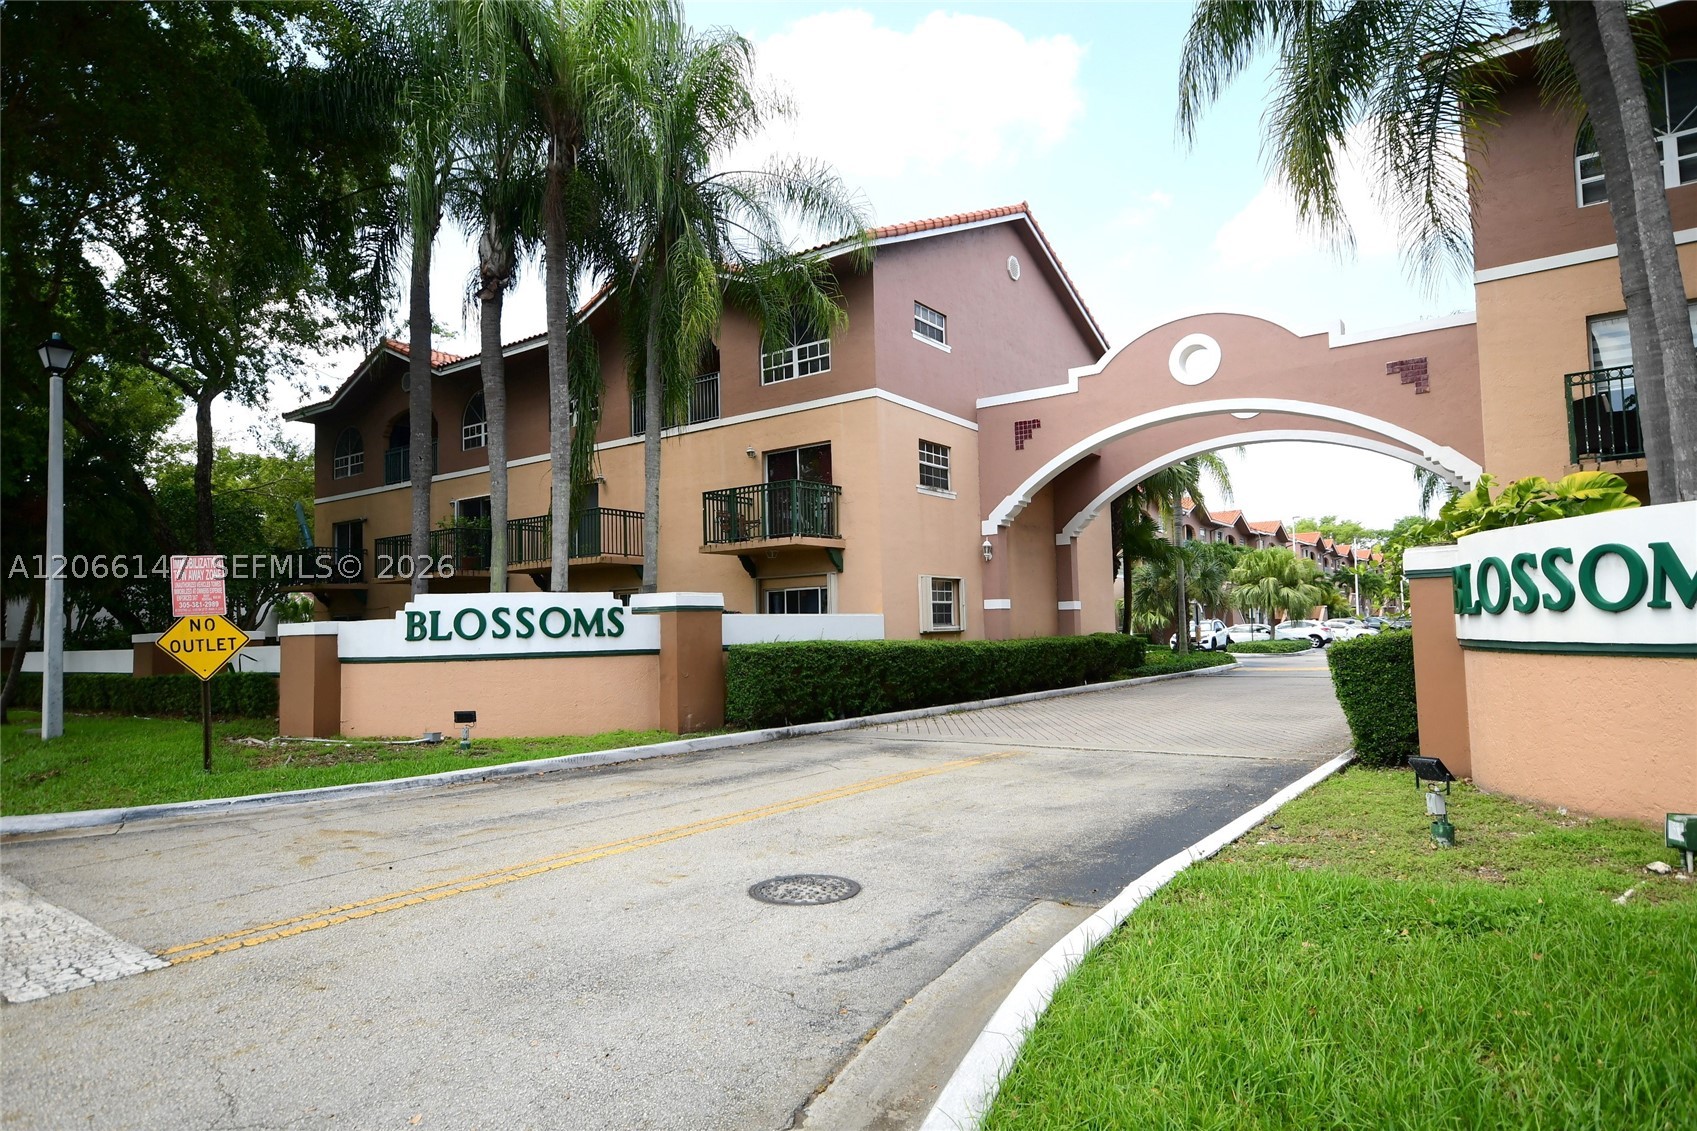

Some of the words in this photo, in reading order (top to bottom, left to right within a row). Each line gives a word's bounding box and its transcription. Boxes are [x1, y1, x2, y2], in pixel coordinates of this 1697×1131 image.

[173, 558, 223, 569] IMBILIZATIN
[173, 569, 187, 581] TW
[188, 569, 205, 580] AWAY
[189, 618, 215, 632] NO
[404, 606, 625, 642] BLOSSOMS
[169, 637, 237, 654] OUTLET
